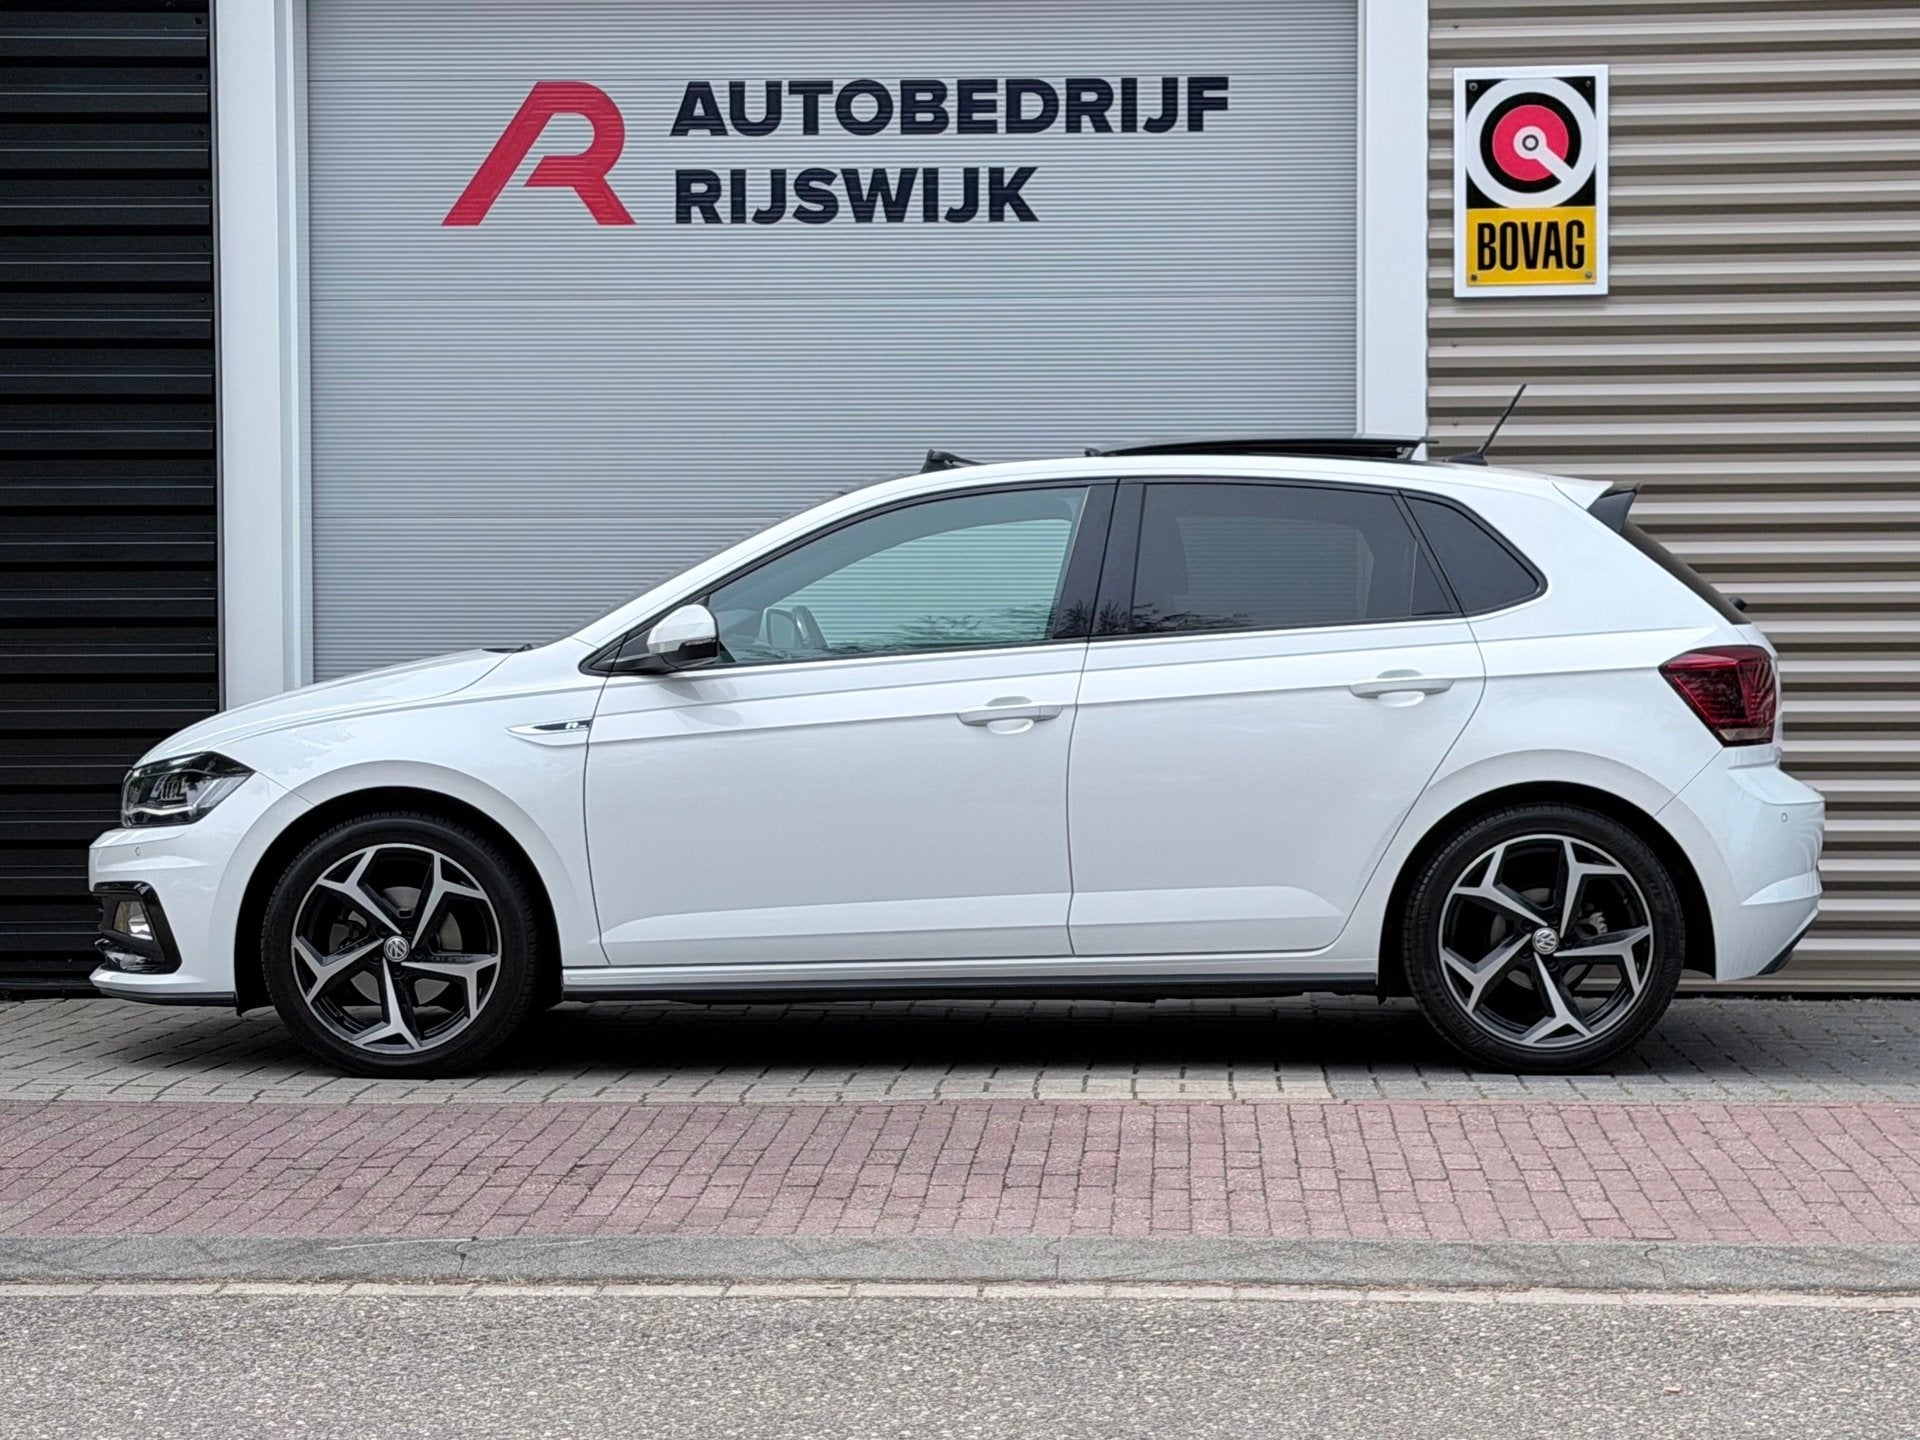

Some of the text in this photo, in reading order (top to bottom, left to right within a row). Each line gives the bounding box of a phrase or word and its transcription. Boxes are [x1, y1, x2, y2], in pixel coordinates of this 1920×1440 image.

[670, 76, 1229, 137] AUTOBEDRIJF
[675, 166, 1038, 224] RIJSWIJK
[1477, 219, 1585, 271] BOVAG
